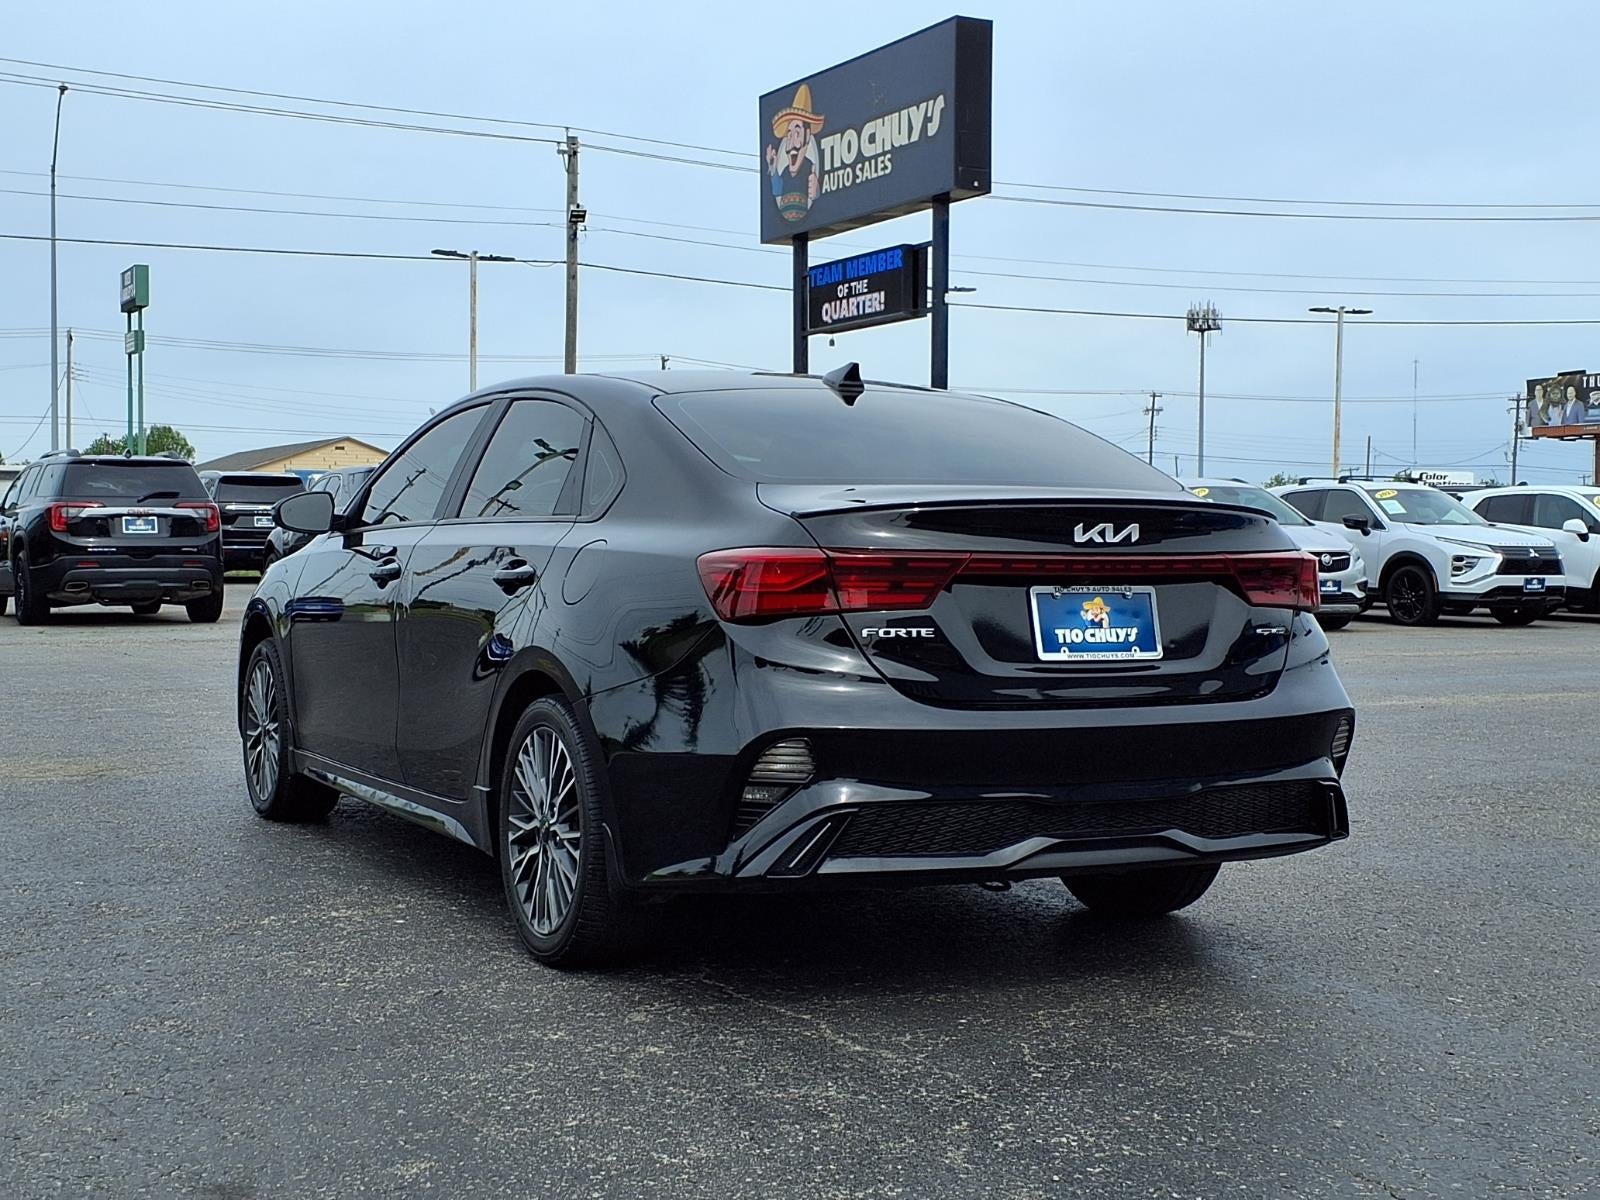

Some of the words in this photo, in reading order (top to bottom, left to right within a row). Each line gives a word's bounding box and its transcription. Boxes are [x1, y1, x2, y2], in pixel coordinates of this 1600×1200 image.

[821, 129, 859, 171] TIO
[860, 94, 945, 157] CHUY'S
[822, 167, 853, 194] AUTO
[855, 153, 892, 183] SALES
[809, 262, 842, 288] TEAM
[846, 248, 903, 279] MEMBER
[837, 283, 850, 298] OF
[850, 279, 868, 295] THE
[821, 291, 885, 324] QUARTER!
[1419, 472, 1448, 481] Color
[1073, 523, 1140, 543] KIA
[861, 627, 935, 638] FORTE
[1054, 628, 1084, 643] TIO
[1084, 627, 1138, 643] CHUY'S
